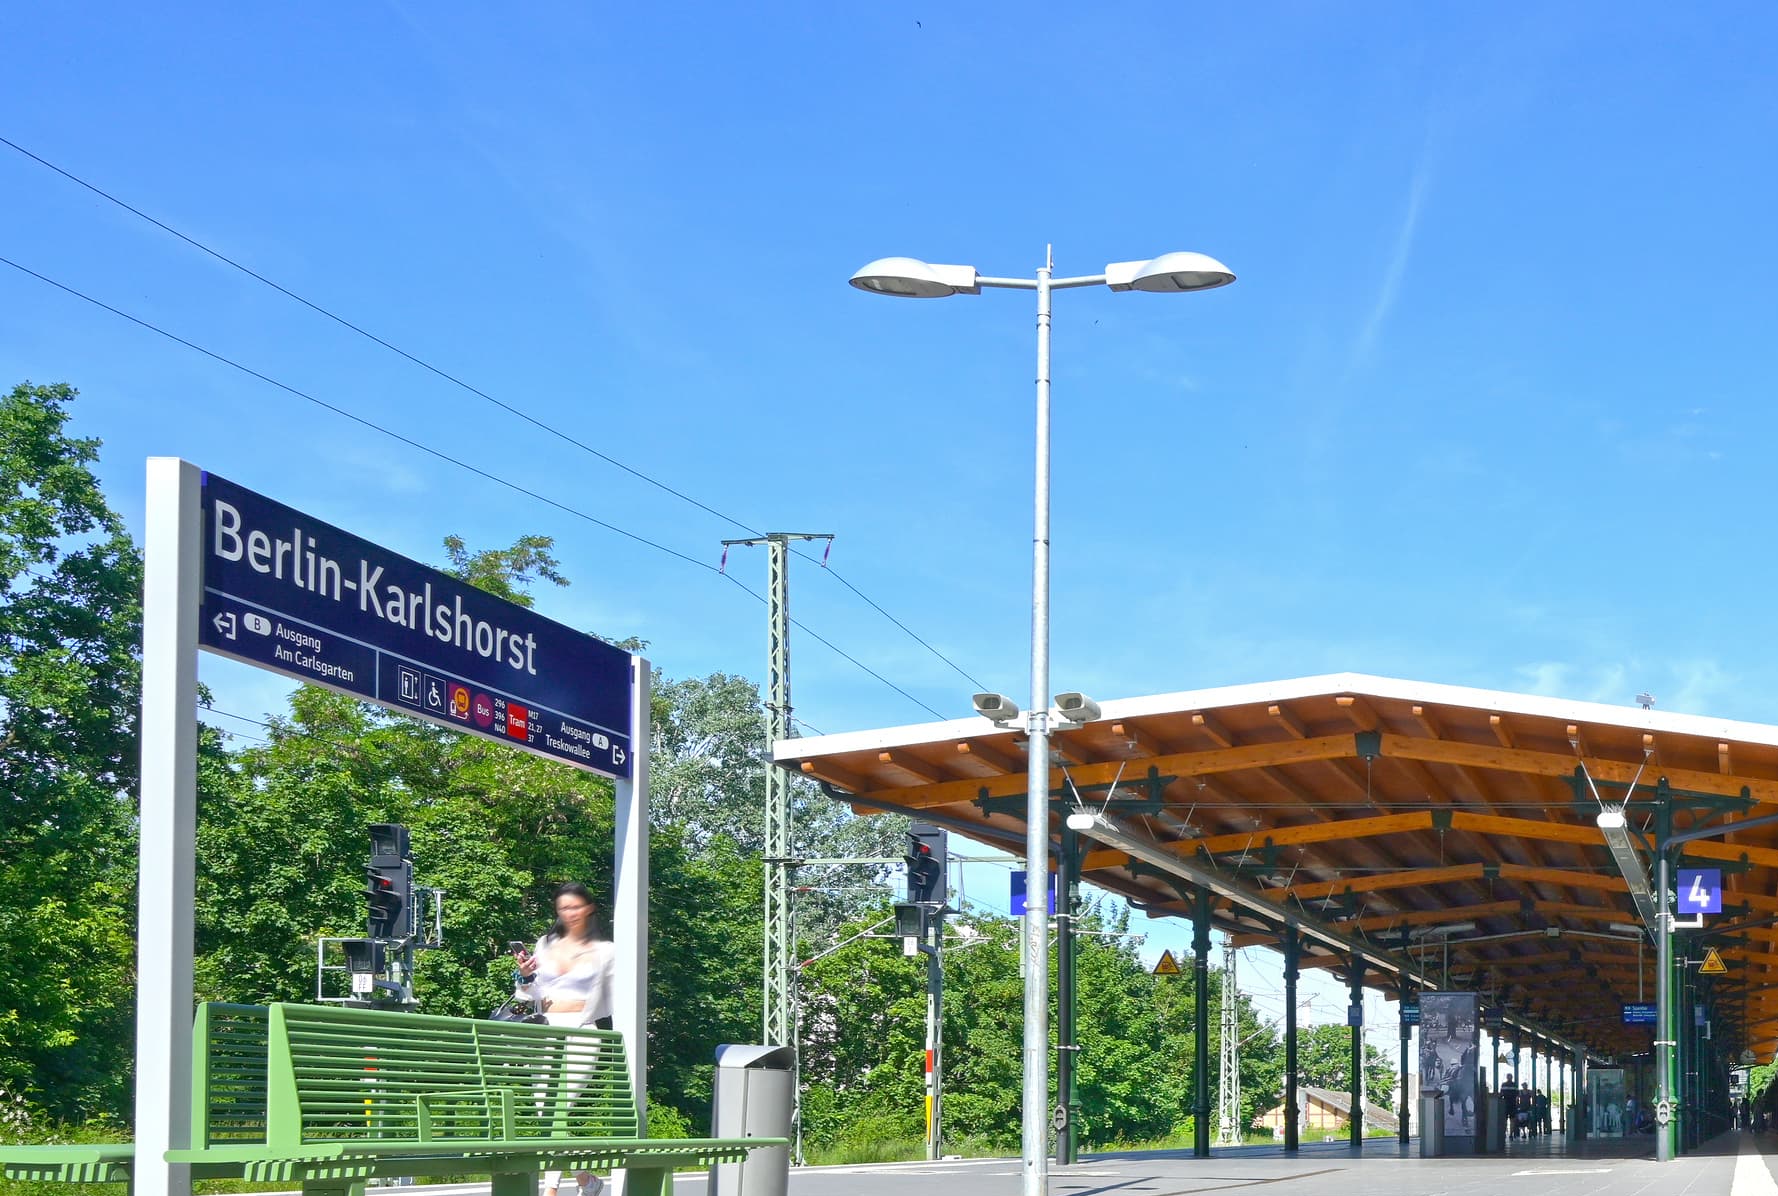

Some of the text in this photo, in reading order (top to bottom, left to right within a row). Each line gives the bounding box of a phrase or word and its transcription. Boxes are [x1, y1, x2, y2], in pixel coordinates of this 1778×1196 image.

[214, 498, 538, 676] Berlin-Karlshorst
[253, 619, 322, 653] B Ausgang
[274, 644, 354, 683] Am Carlsgarten
[477, 703, 490, 717] Bus
[494, 698, 506, 709] 296
[494, 710, 506, 722] 396
[494, 722, 506, 735] N40
[508, 713, 526, 729] Tram
[560, 721, 604, 747] Ausgang A
[545, 733, 592, 760] Treskowallee
[1688, 873, 1711, 908] 4
